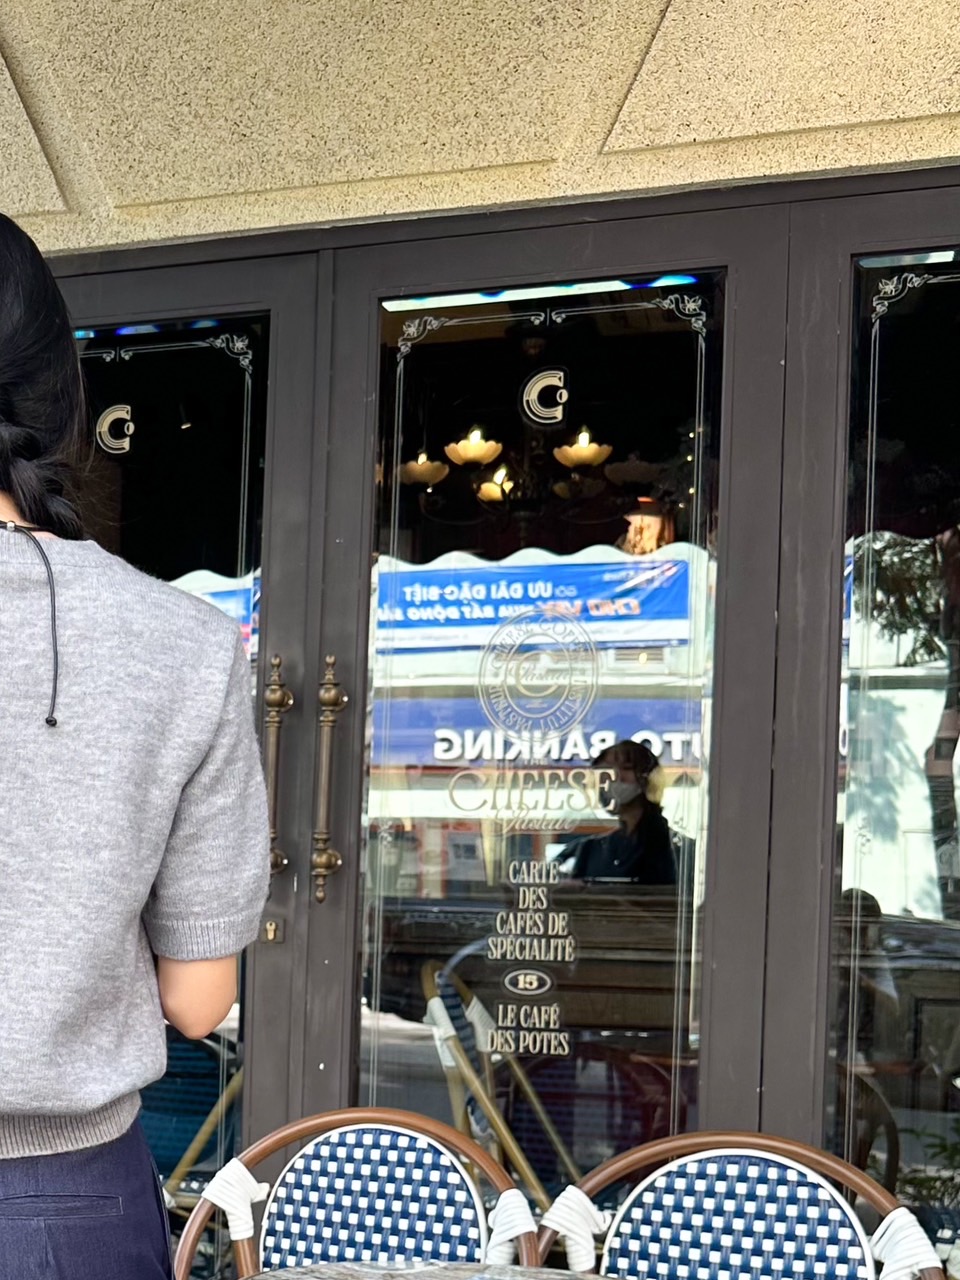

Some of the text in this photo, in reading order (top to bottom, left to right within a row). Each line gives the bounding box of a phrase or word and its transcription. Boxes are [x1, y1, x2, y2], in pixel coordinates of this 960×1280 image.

[448, 768, 616, 811] CHEESE
[509, 861, 559, 884] CARTE
[519, 886, 548, 909] DES
[496, 909, 568, 935] CAFÉS DE
[488, 934, 575, 961] SPÉCIALITÉ
[517, 974, 539, 990] 15
[498, 1002, 559, 1029] LE CAFÉ
[487, 1028, 570, 1055] DES POTES
